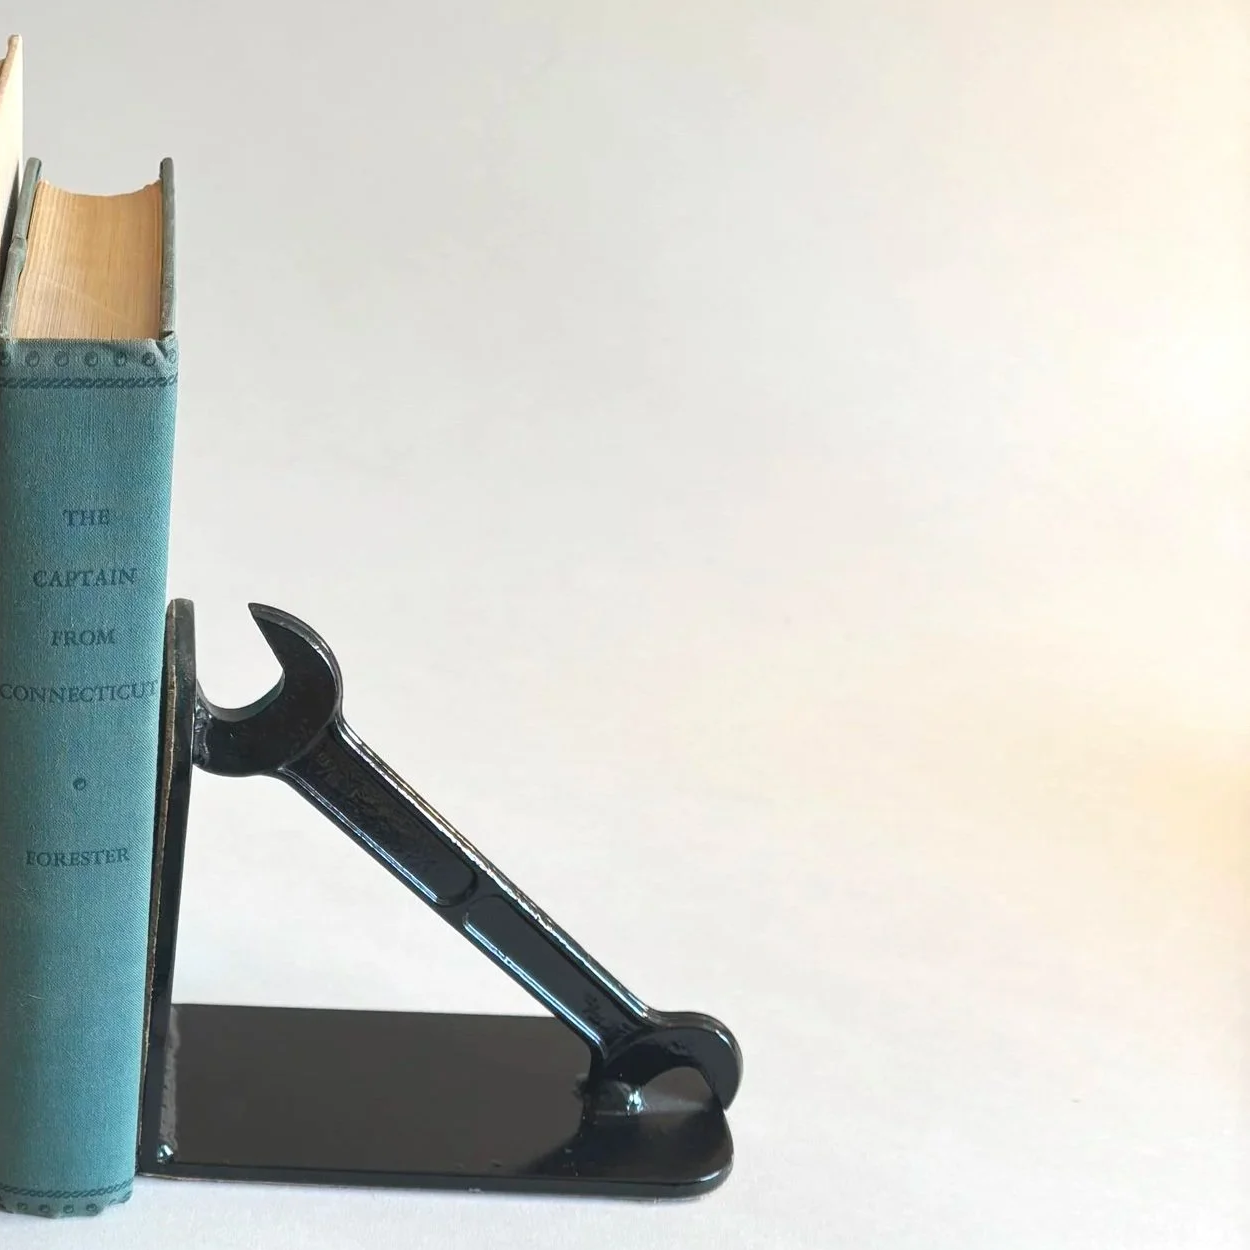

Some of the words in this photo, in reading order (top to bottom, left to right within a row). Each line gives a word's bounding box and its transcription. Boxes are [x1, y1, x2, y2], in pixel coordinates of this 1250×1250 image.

[62, 508, 111, 527] THE
[32, 567, 138, 589] CAPTAIN
[51, 628, 116, 648] FROM
[25, 847, 131, 869] FORESTER
